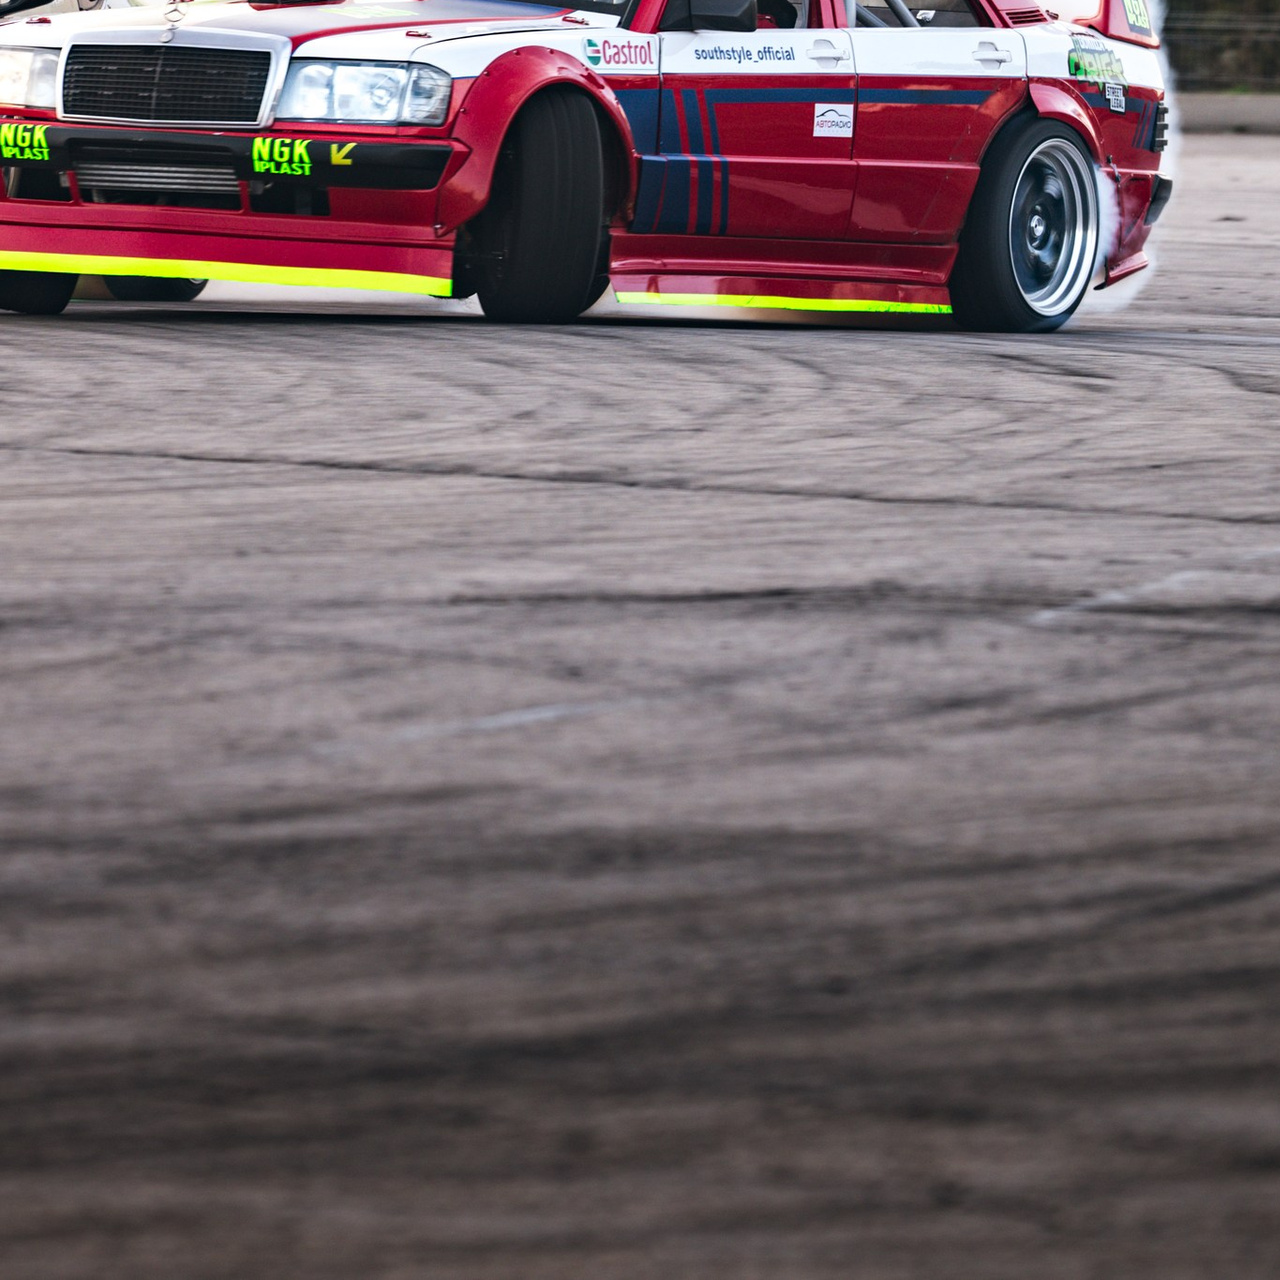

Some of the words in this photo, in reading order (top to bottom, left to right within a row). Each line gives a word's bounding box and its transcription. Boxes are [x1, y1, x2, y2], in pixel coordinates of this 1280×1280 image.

[601, 39, 654, 65] Castrol
[694, 46, 796, 64] southstyle_official
[0, 123, 52, 148] NGK
[252, 137, 313, 163] NGK
